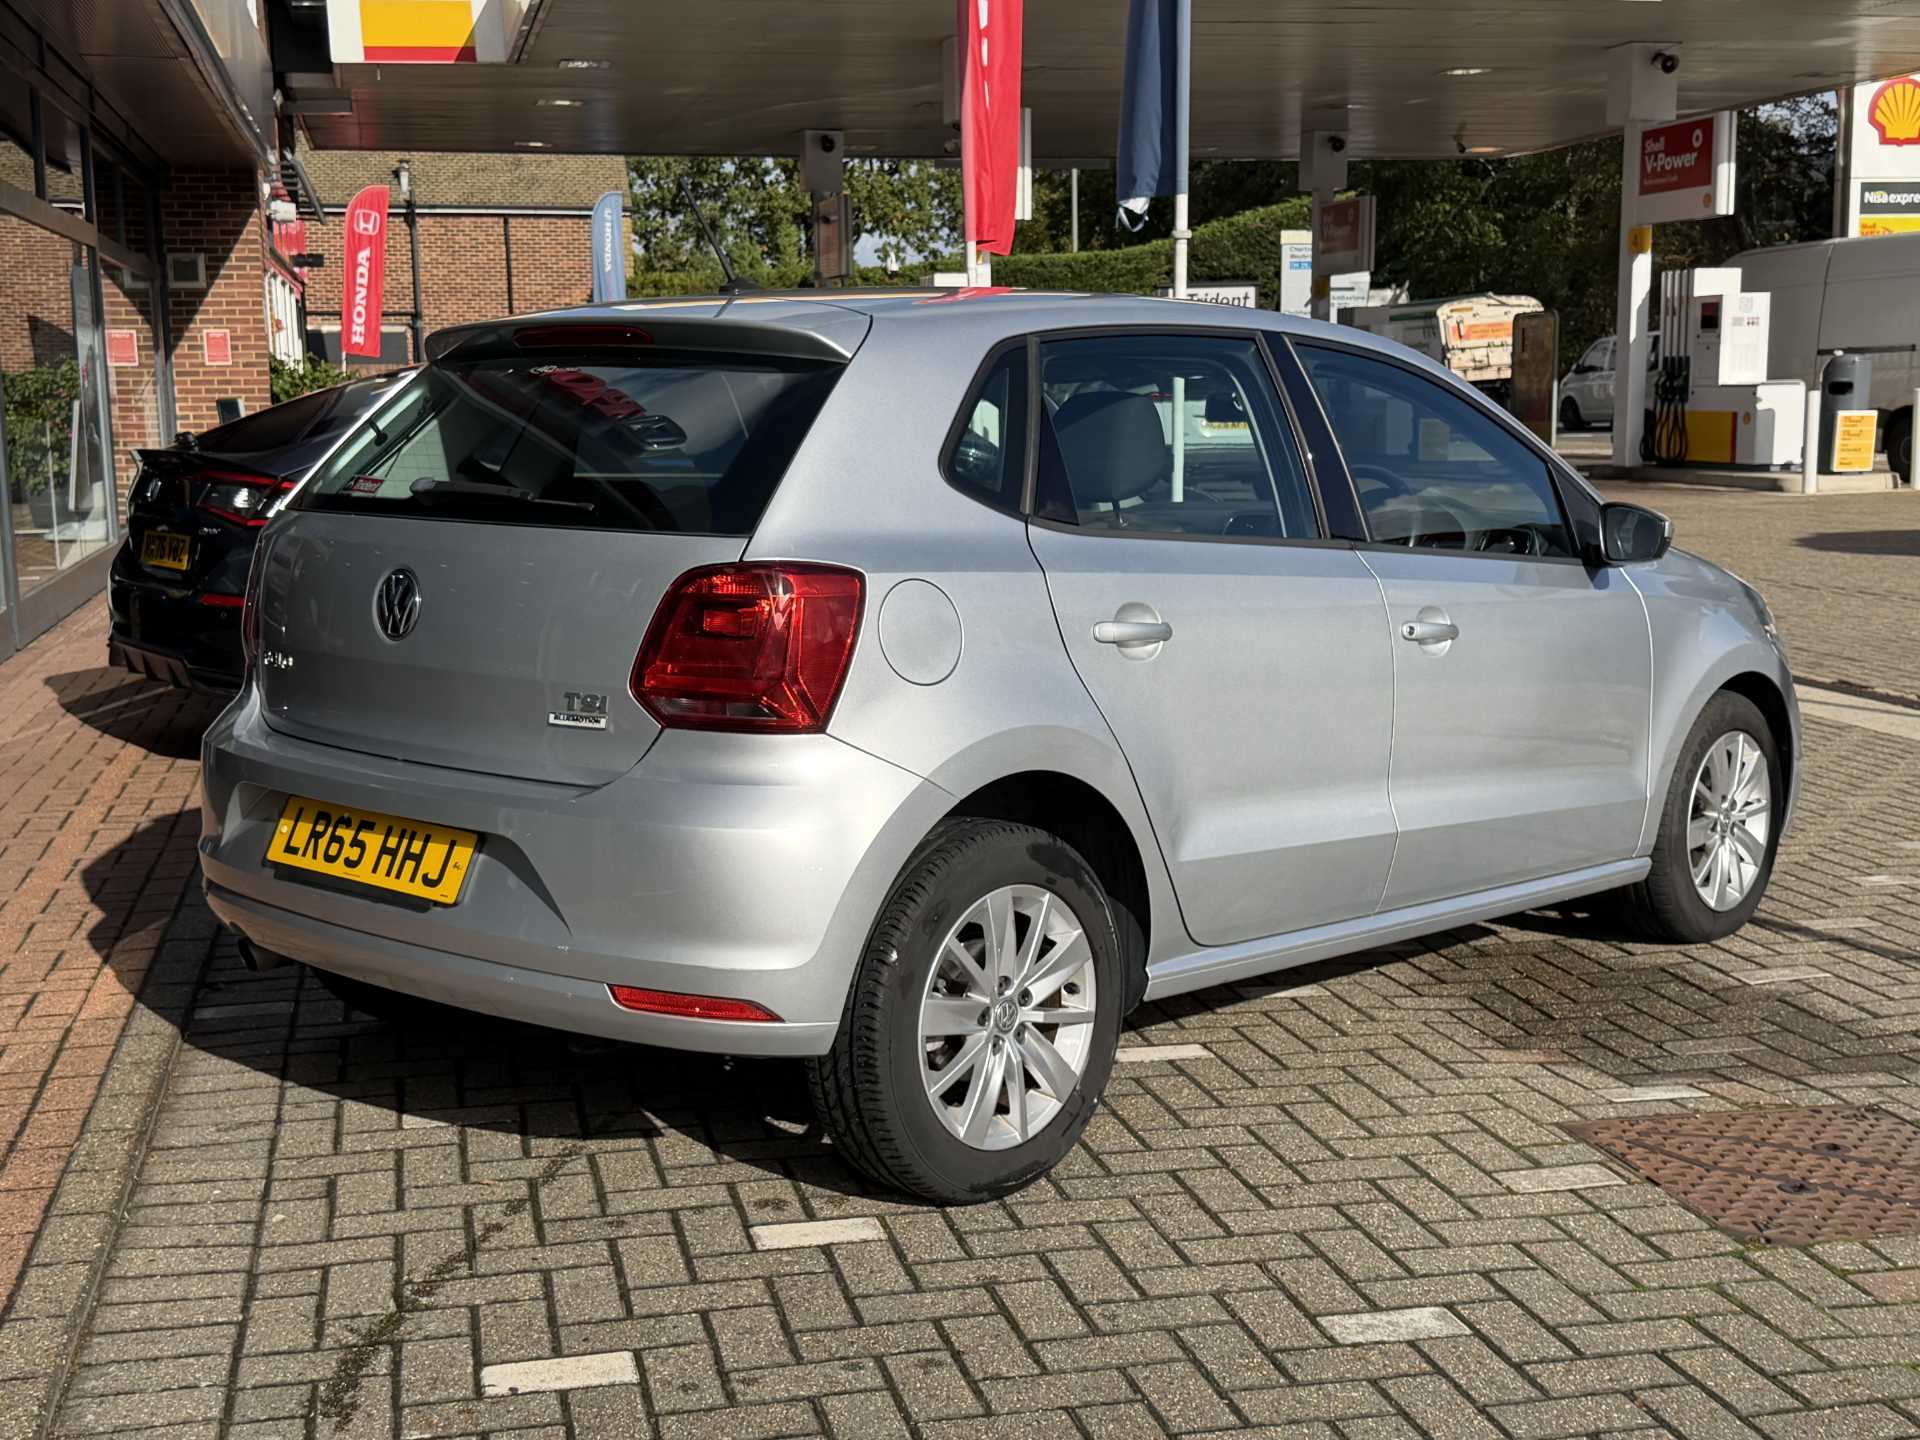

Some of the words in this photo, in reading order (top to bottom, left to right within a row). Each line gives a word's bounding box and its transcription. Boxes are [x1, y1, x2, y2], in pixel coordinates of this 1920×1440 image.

[1645, 151, 1699, 174] V-Power
[351, 246, 371, 345] HONDA
[564, 691, 608, 714] TSI
[283, 807, 377, 869] LR65
[371, 825, 457, 888] HHJ
